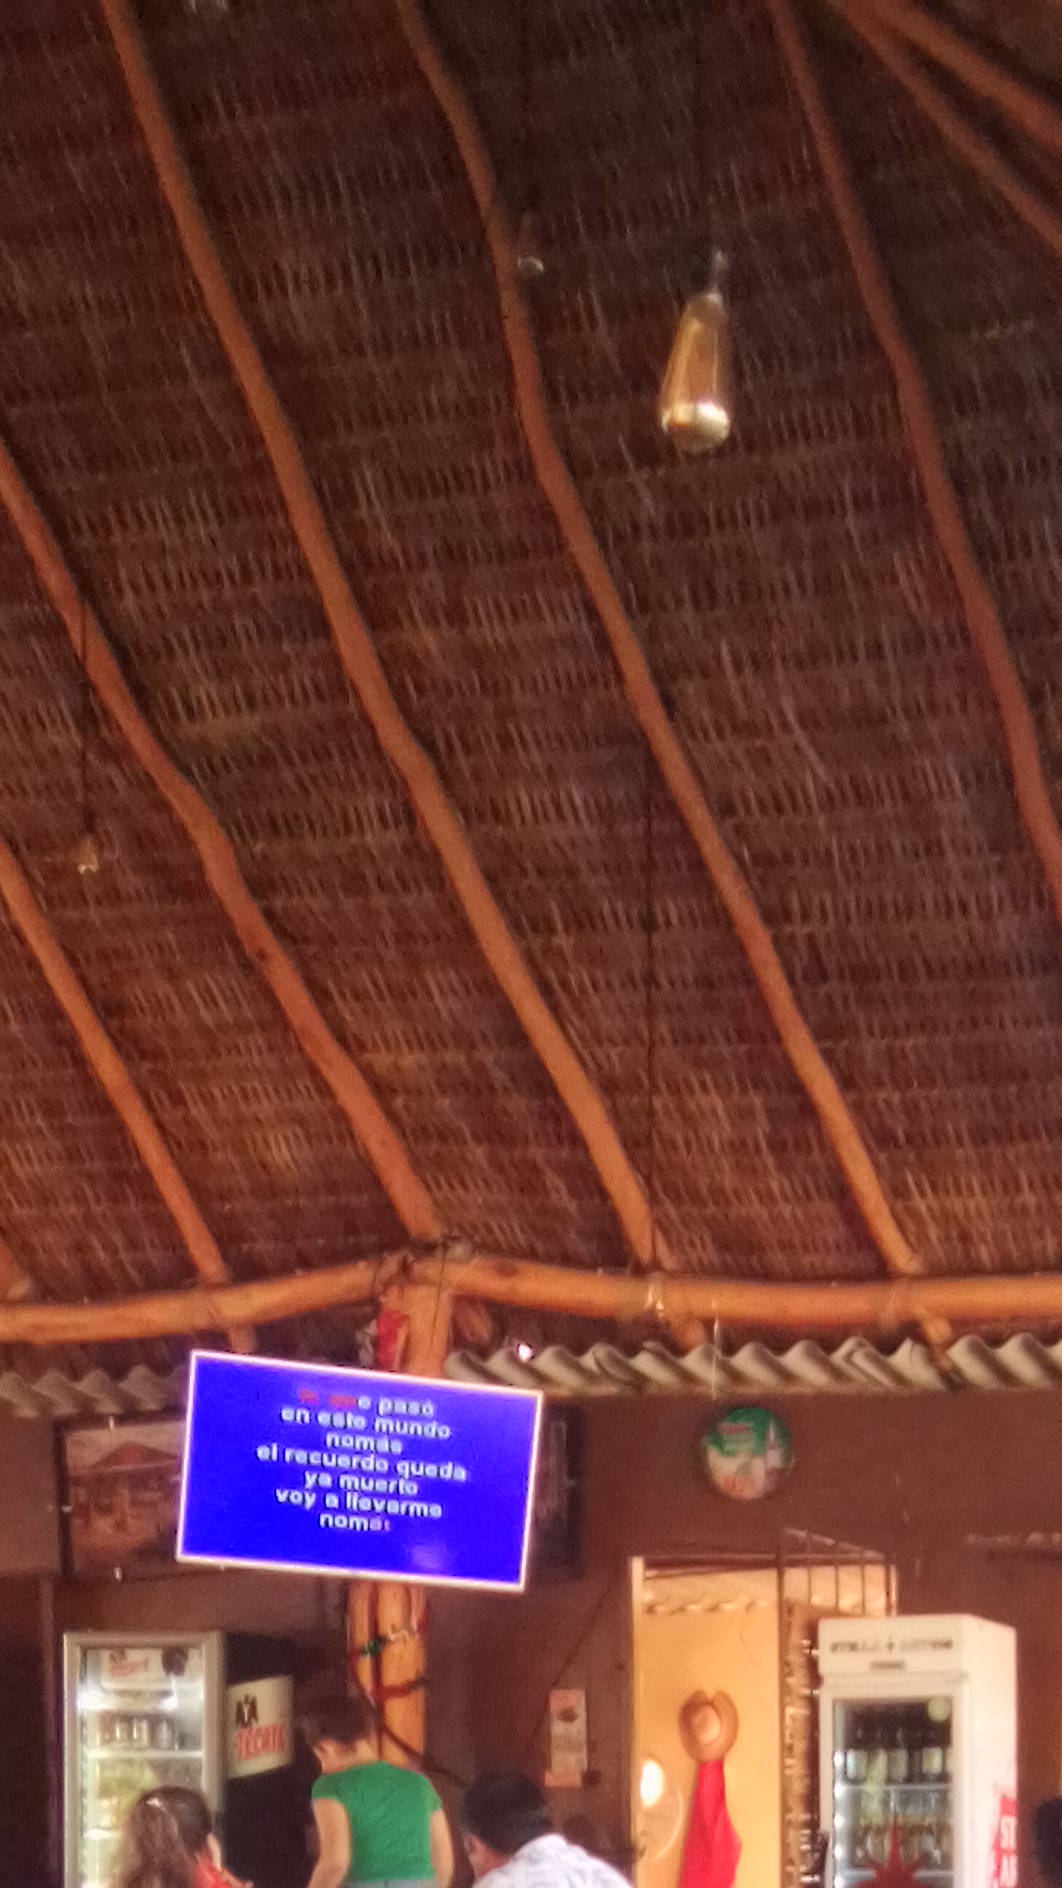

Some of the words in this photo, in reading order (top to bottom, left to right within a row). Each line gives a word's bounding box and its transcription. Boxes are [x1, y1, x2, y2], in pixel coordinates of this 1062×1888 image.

[375, 1418, 451, 1440] mundo
[256, 1442, 279, 1461] el
[284, 1447, 389, 1474] recuerdo
[396, 1460, 467, 1482] queda
[338, 1474, 418, 1495] muerto
[275, 1488, 317, 1510] voy
